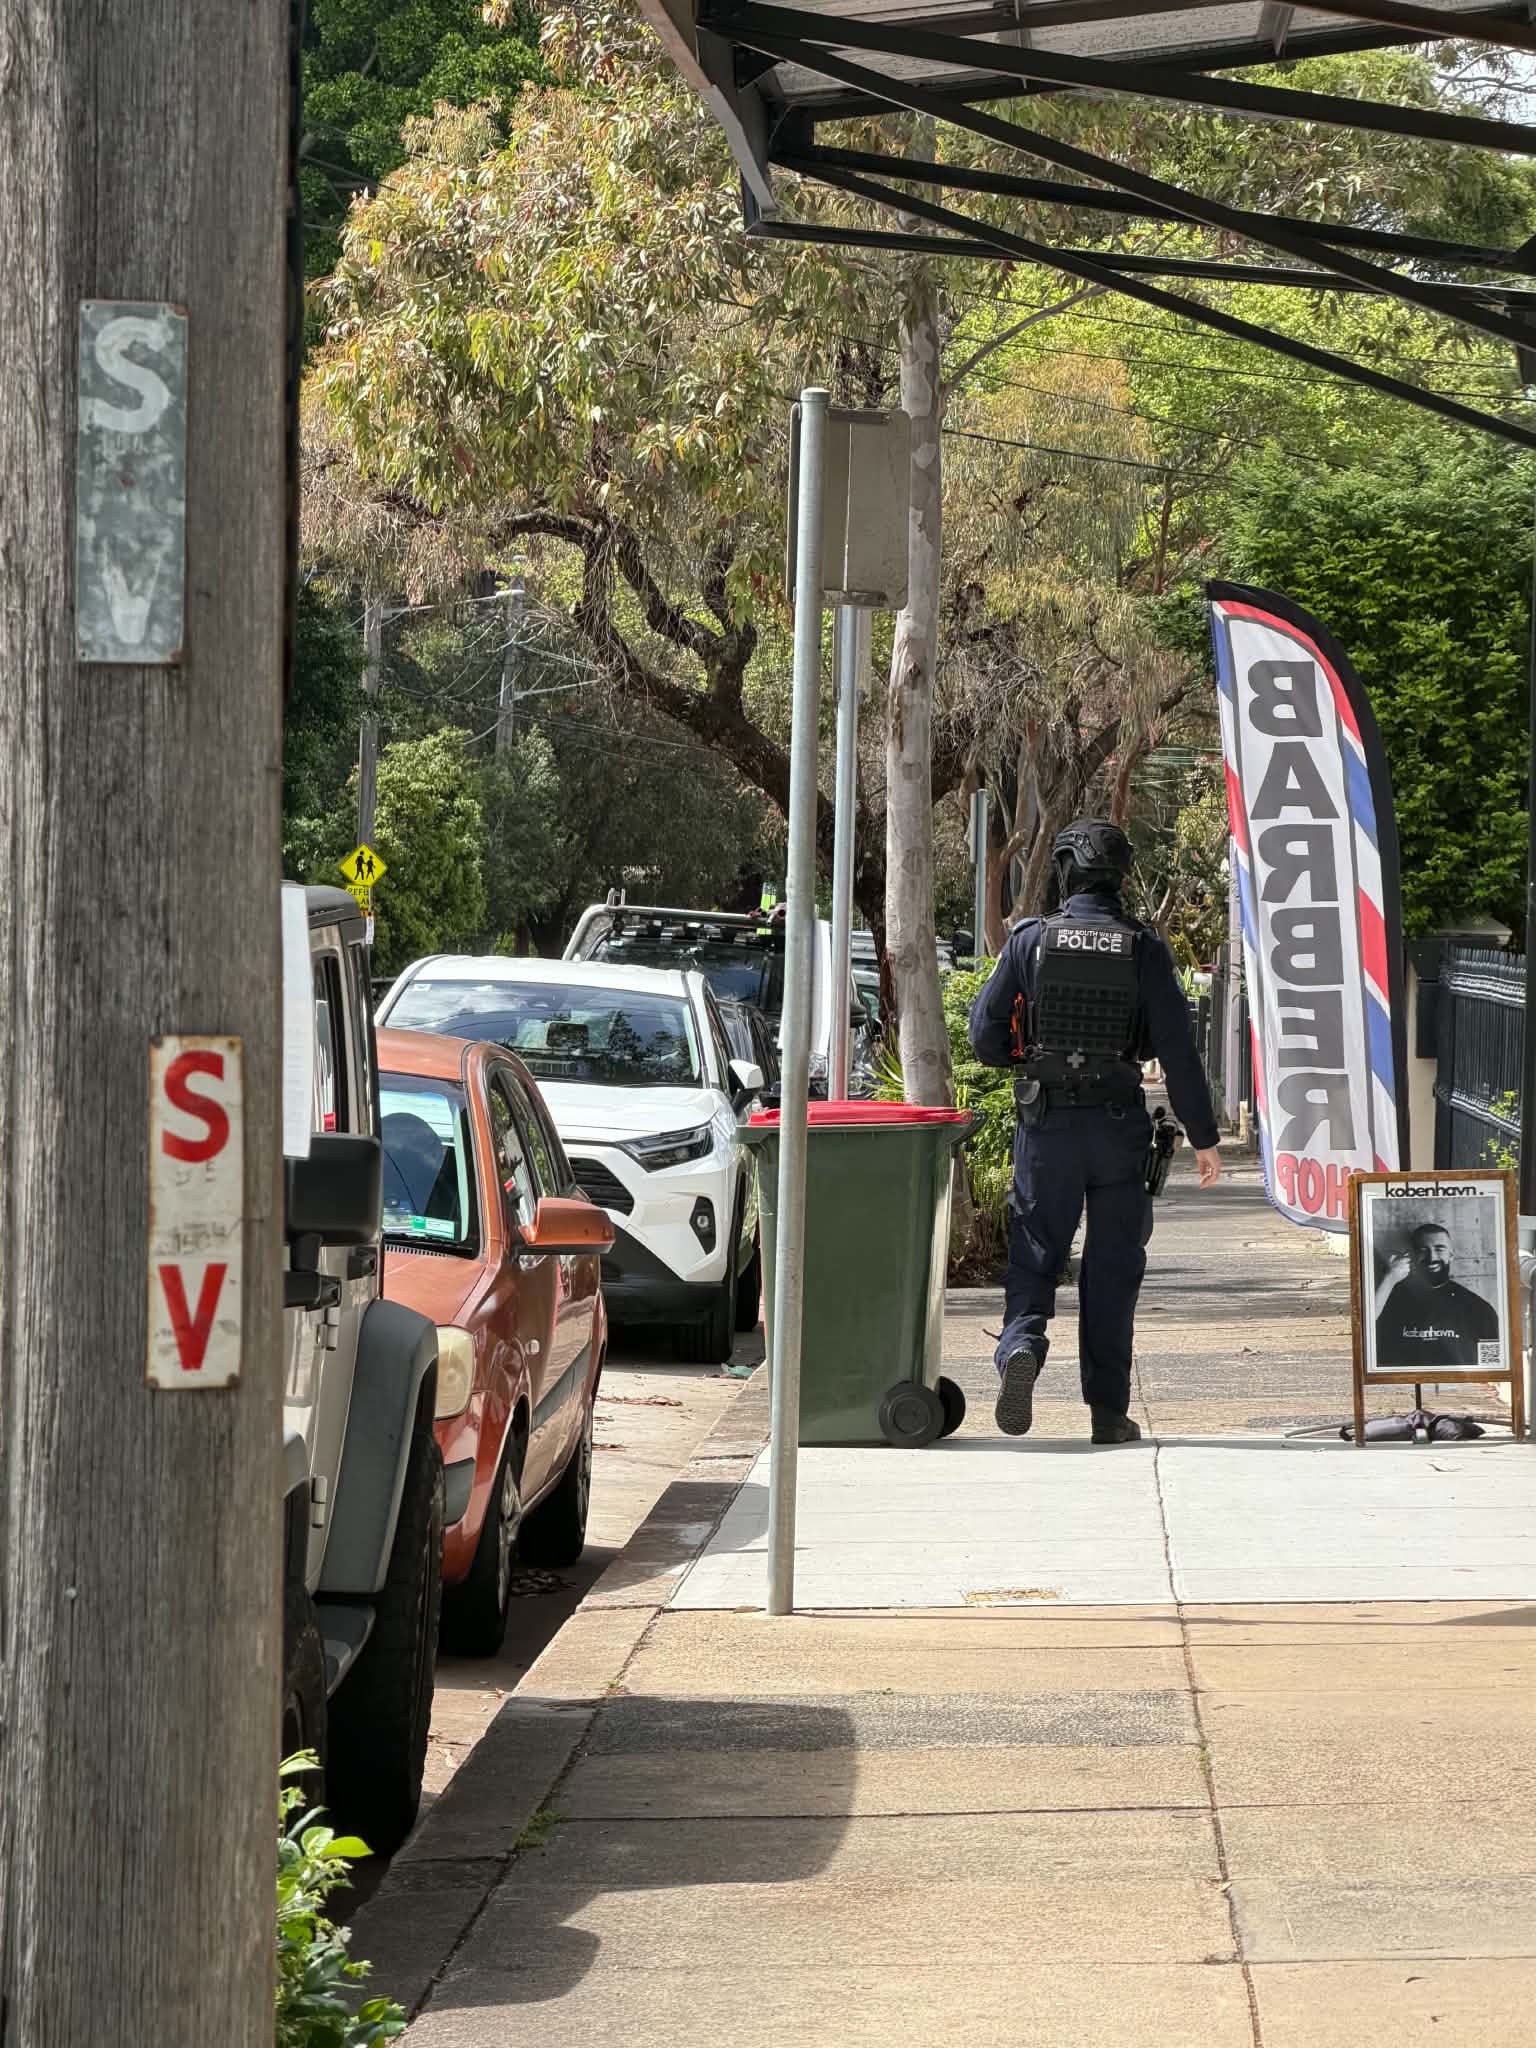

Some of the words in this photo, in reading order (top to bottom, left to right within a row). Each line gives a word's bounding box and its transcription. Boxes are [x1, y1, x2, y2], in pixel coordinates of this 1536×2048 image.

[82, 315, 172, 432] S
[99, 532, 172, 642] V
[1056, 934, 1122, 952] POLICE
[161, 1050, 230, 1163] S
[158, 1263, 228, 1370] V
